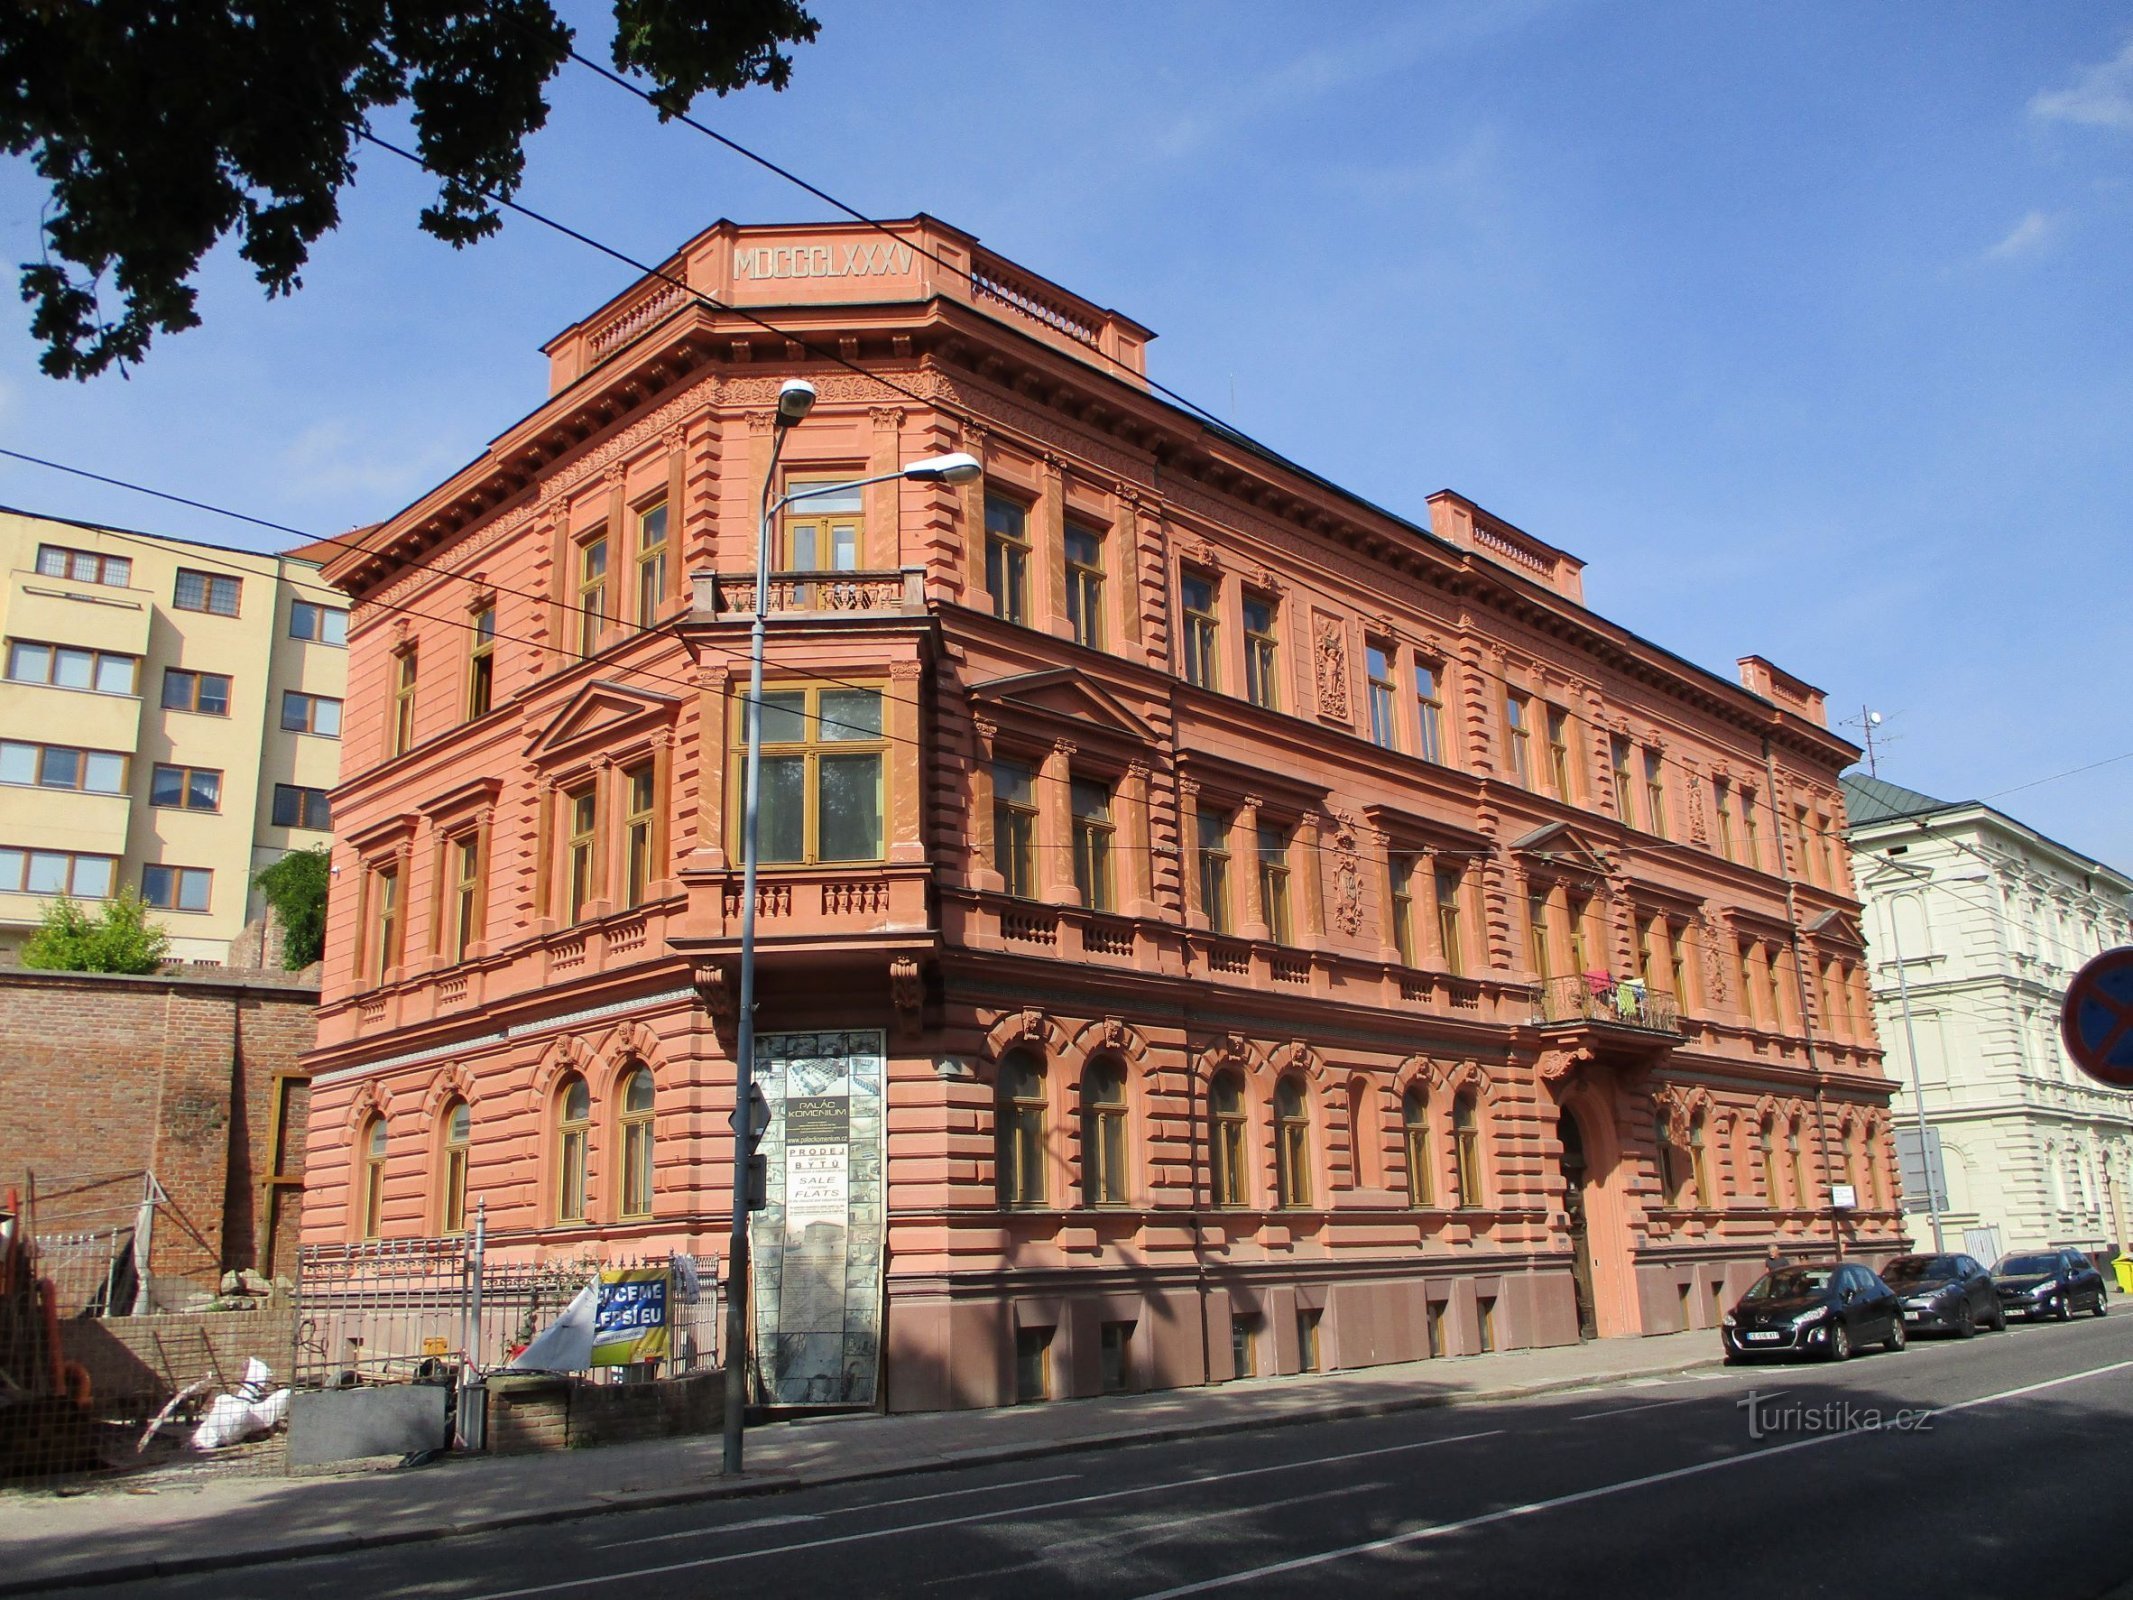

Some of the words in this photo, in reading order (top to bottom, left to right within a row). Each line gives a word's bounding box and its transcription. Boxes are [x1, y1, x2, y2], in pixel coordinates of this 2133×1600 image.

[733, 243, 914, 280] MDCCCLXXXV
[799, 1099, 836, 1109] PALÁC
[788, 1108, 847, 1118] KOMENIUM
[789, 1147, 845, 1156] PRODEJ
[795, 1160, 839, 1169] BYTŮ
[799, 1176, 837, 1184] SALE
[795, 1189, 840, 1198] FLATS
[640, 1307, 662, 1324] EU
